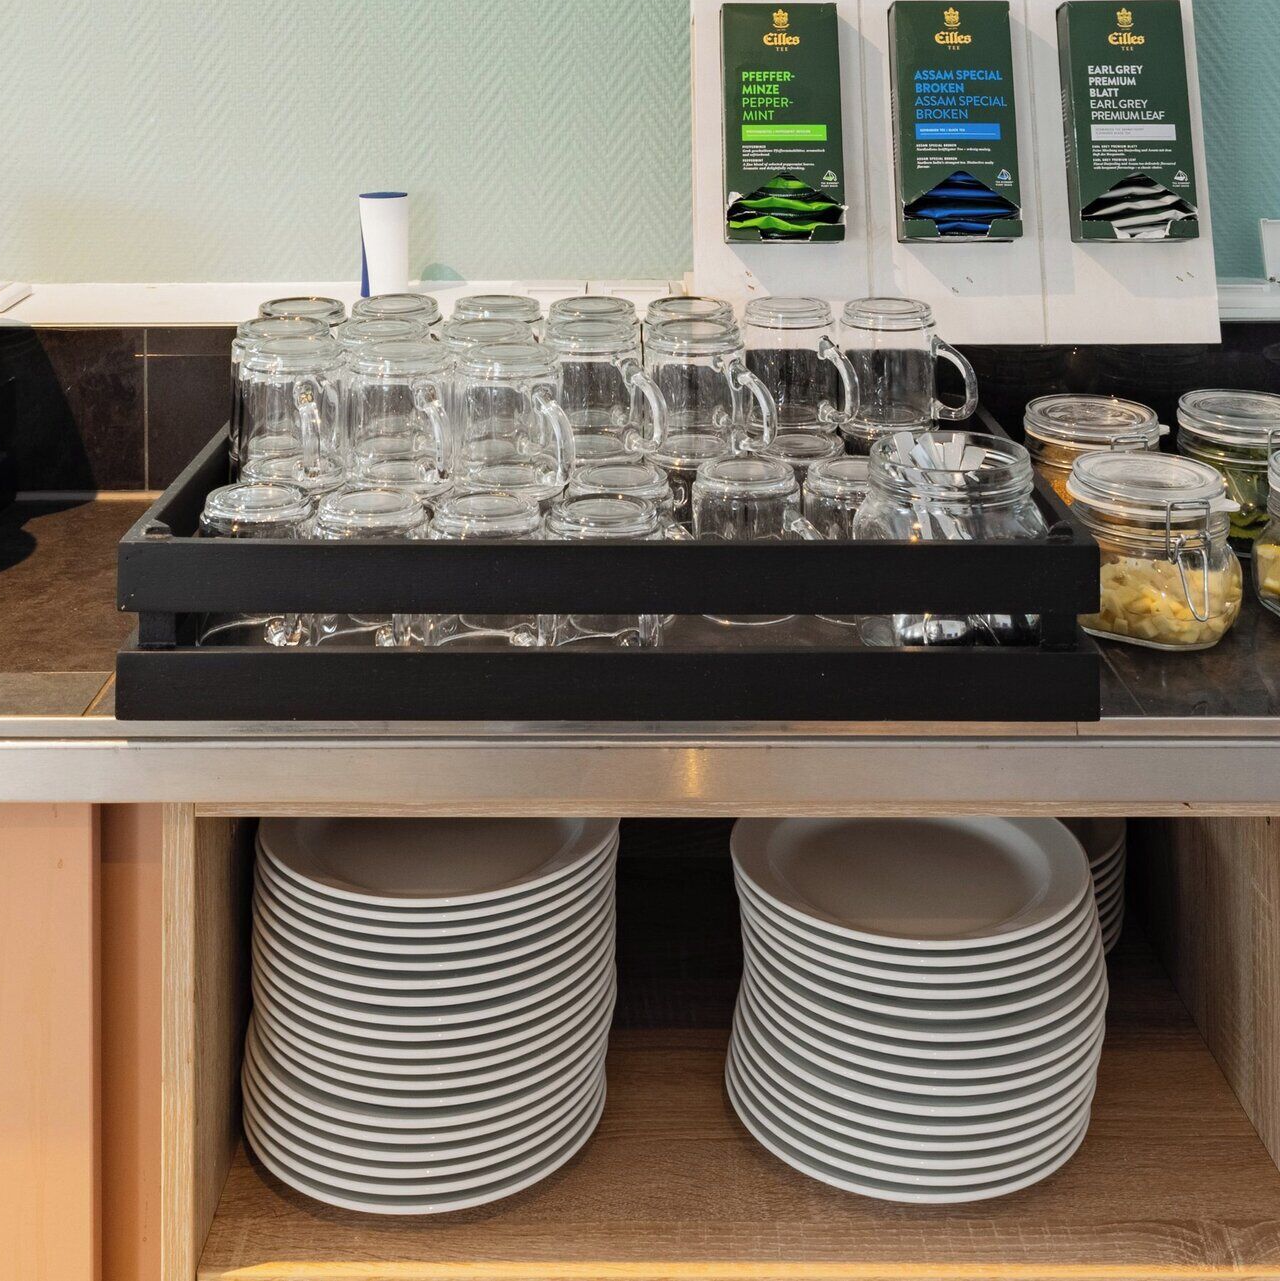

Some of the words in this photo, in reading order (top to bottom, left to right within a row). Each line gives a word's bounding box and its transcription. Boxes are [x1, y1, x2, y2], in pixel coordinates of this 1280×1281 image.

[763, 32, 800, 46] Eilles
[934, 31, 972, 44] Eilles
[1108, 32, 1145, 45] Eilles
[914, 70, 954, 80] ASSAM
[955, 70, 1003, 80] SPECIAL
[1087, 65, 1114, 75] EARL
[1115, 65, 1143, 75] GREY
[742, 71, 796, 82] PFEFFER-
[1088, 76, 1136, 86] PREMIUM
[742, 84, 780, 95] MINZE
[915, 83, 965, 93] BROKEN
[1089, 88, 1119, 97] BLATT
[742, 97, 794, 108] PEPPER-
[915, 96, 956, 106] ASSAM
[959, 96, 1008, 106] SPECIAL
[1090, 99, 1118, 109] EARL
[1118, 99, 1148, 109] GREY
[743, 110, 775, 121] MINT
[916, 109, 969, 119] BROKEN
[1091, 111, 1140, 120] PREMIUM
[1141, 111, 1165, 120] LEAF
